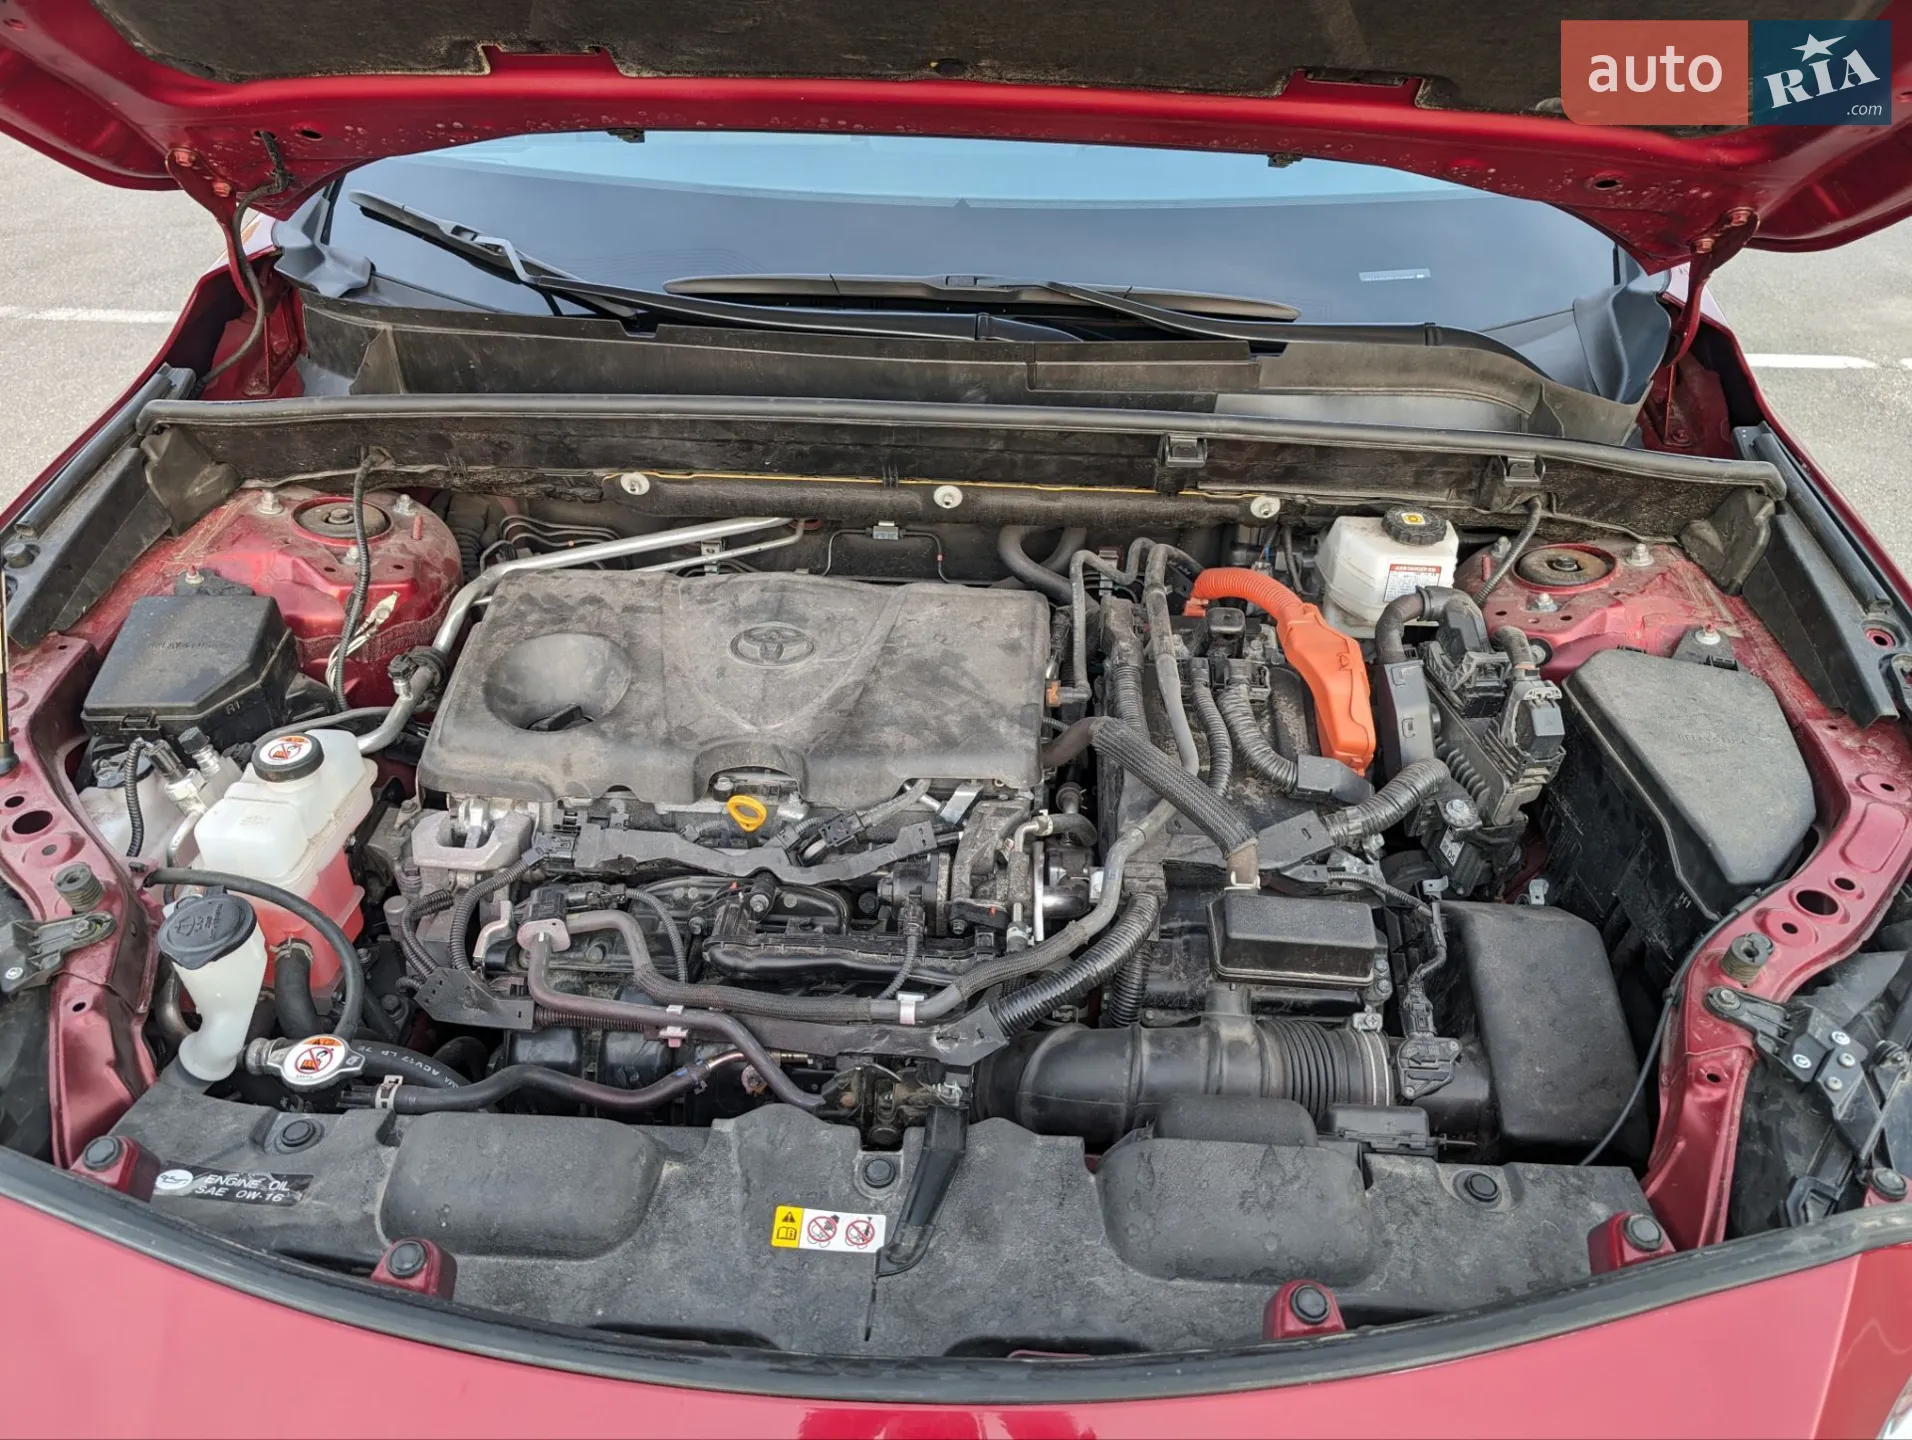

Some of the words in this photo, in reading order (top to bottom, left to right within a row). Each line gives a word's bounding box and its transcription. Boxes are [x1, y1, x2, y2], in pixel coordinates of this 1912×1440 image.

[204, 1174, 261, 1189] ENGINE
[268, 1181, 290, 1191] OIL
[195, 1185, 228, 1196] SAE
